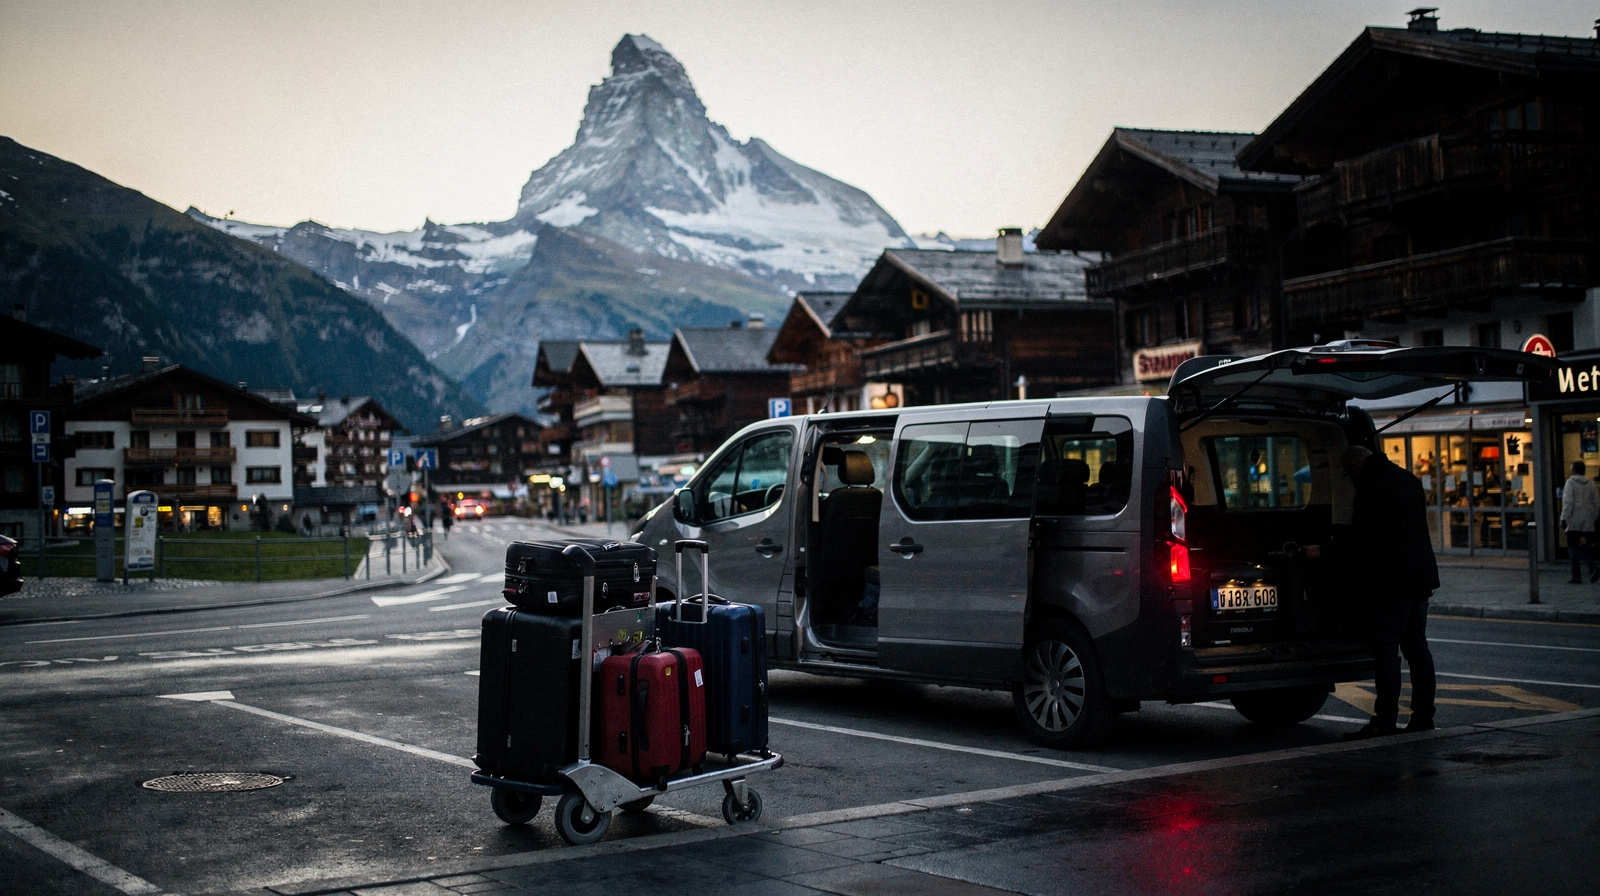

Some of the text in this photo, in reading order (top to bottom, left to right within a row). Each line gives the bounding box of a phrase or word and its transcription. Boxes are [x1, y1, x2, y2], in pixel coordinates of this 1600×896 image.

[774, 400, 787, 418] P
[35, 413, 46, 431] P
[391, 451, 401, 466] P
